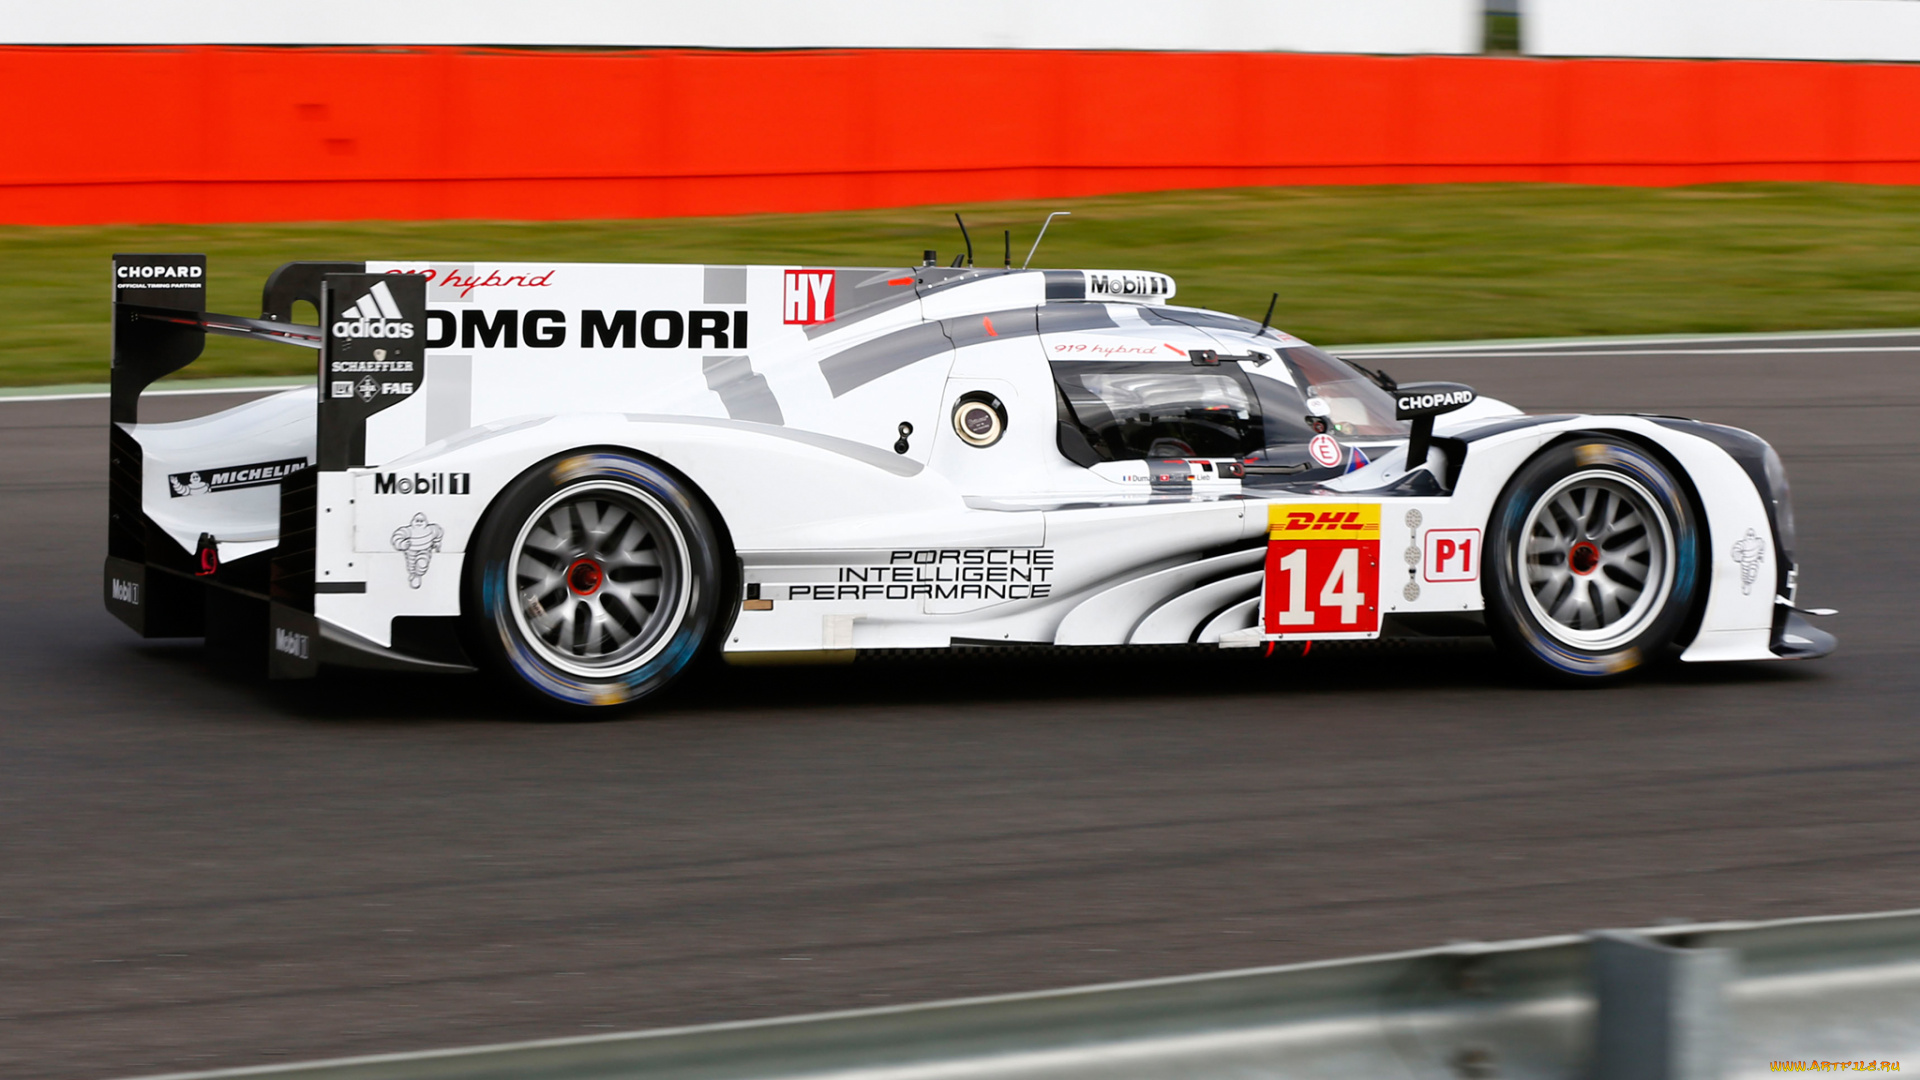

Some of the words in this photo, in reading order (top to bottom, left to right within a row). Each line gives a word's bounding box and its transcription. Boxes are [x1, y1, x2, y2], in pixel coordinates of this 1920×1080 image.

[117, 266, 202, 278] CHOPARD
[438, 269, 556, 298] hybrid
[1091, 275, 1147, 294] Mobil
[1151, 276, 1166, 294] 1
[785, 273, 833, 321] HY
[332, 317, 415, 339] adidas
[425, 309, 566, 349] DMG
[580, 309, 748, 349] MORI
[1054, 344, 1087, 353] 919
[1091, 344, 1158, 358] hybrid
[331, 361, 414, 373] SCHAEFFLER
[381, 382, 414, 395] FAG
[1398, 391, 1473, 410] CHOPARD
[1319, 445, 1333, 460] E
[211, 462, 306, 485] MICHELIN
[374, 472, 444, 495] Mobil
[451, 472, 468, 494] 1
[1285, 512, 1364, 531] DHL
[890, 549, 1054, 565] PORSCHE
[1435, 539, 1472, 573] P1
[839, 567, 1054, 582] INTELLIGENT
[112, 578, 131, 602] Mobil
[788, 584, 1052, 600] PERFORMANCE
[1279, 548, 1365, 626] 14
